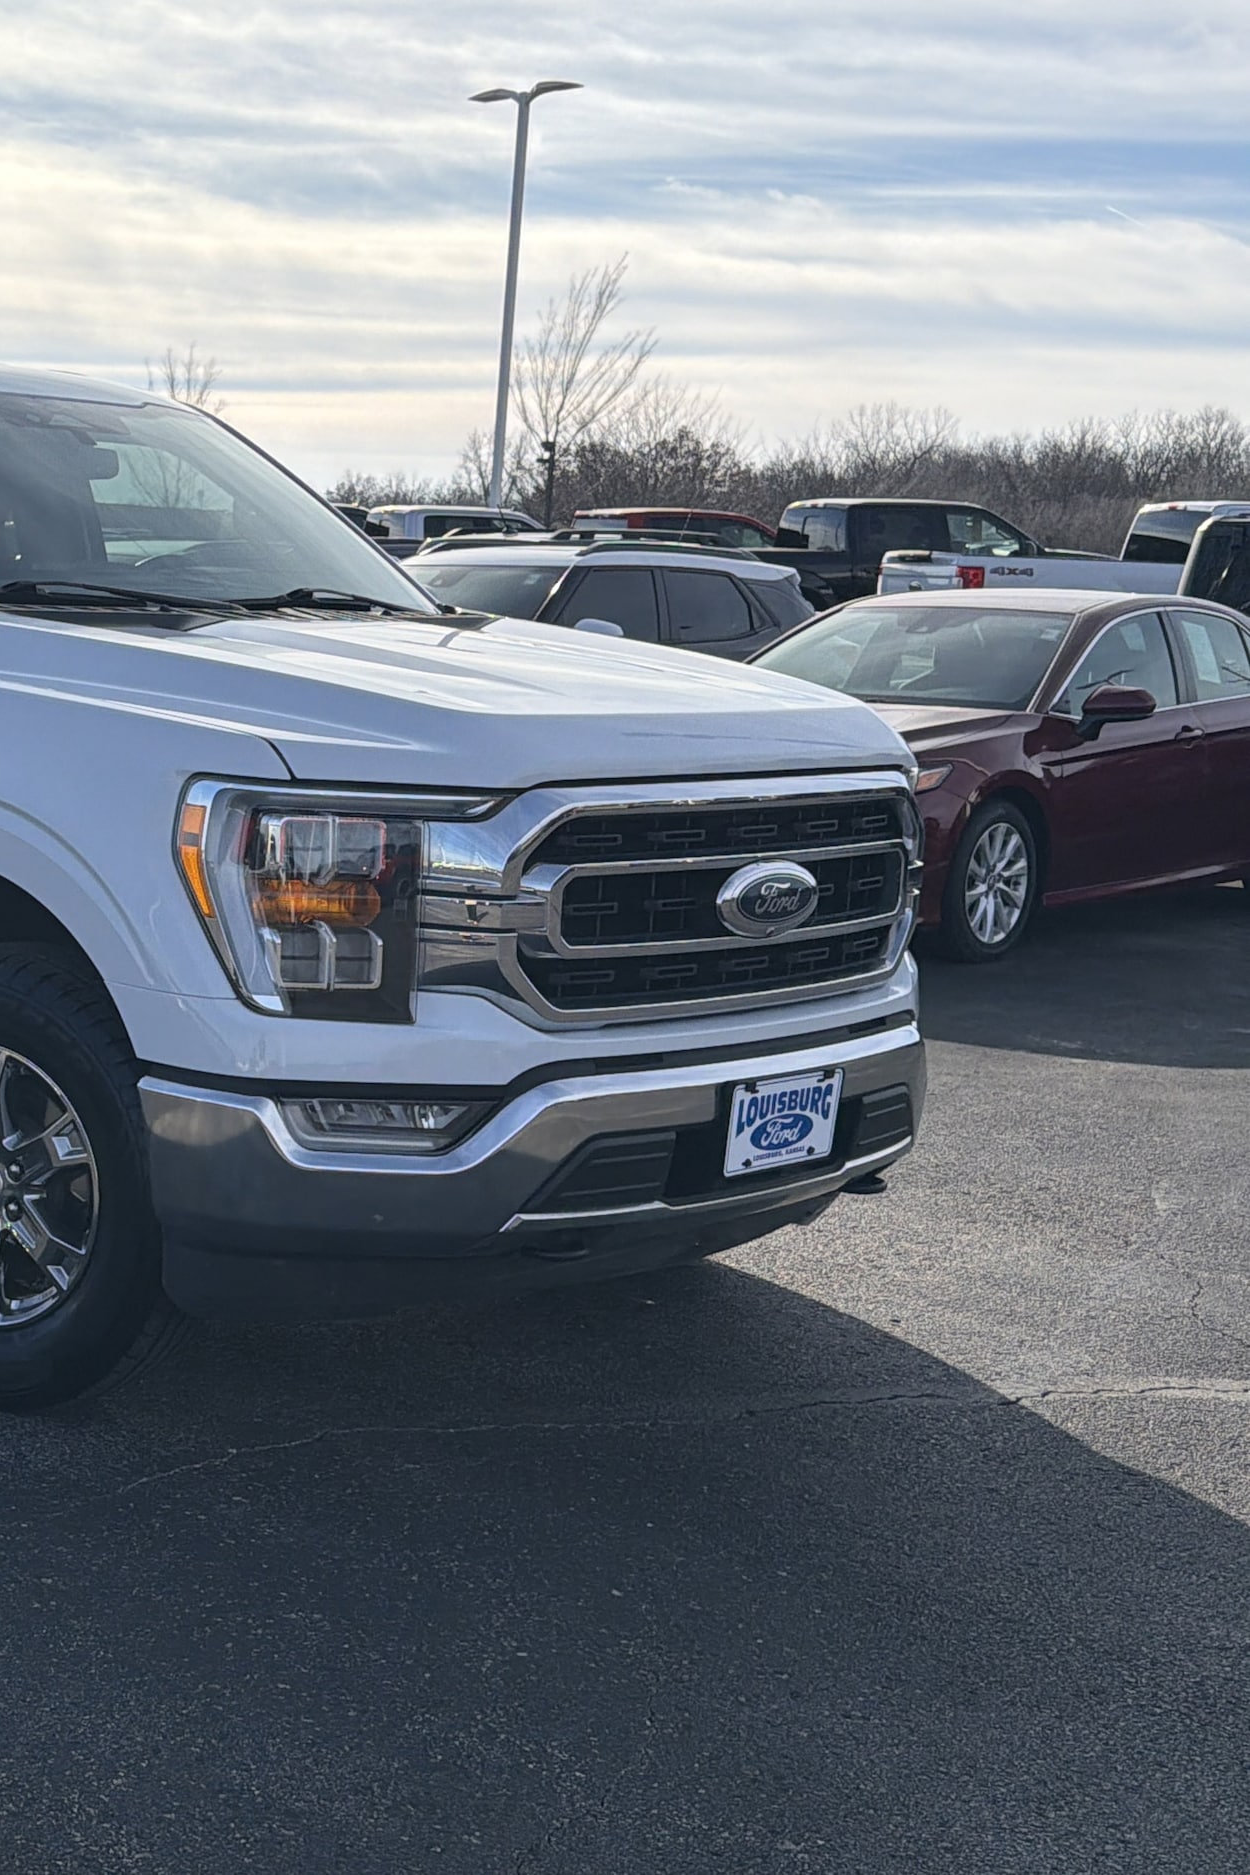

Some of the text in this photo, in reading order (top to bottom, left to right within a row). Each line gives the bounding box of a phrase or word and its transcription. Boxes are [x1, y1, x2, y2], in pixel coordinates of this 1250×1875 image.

[755, 882, 802, 914] Ford
[735, 1083, 834, 1138] LOUISBURG
[761, 1117, 802, 1147] Ford
